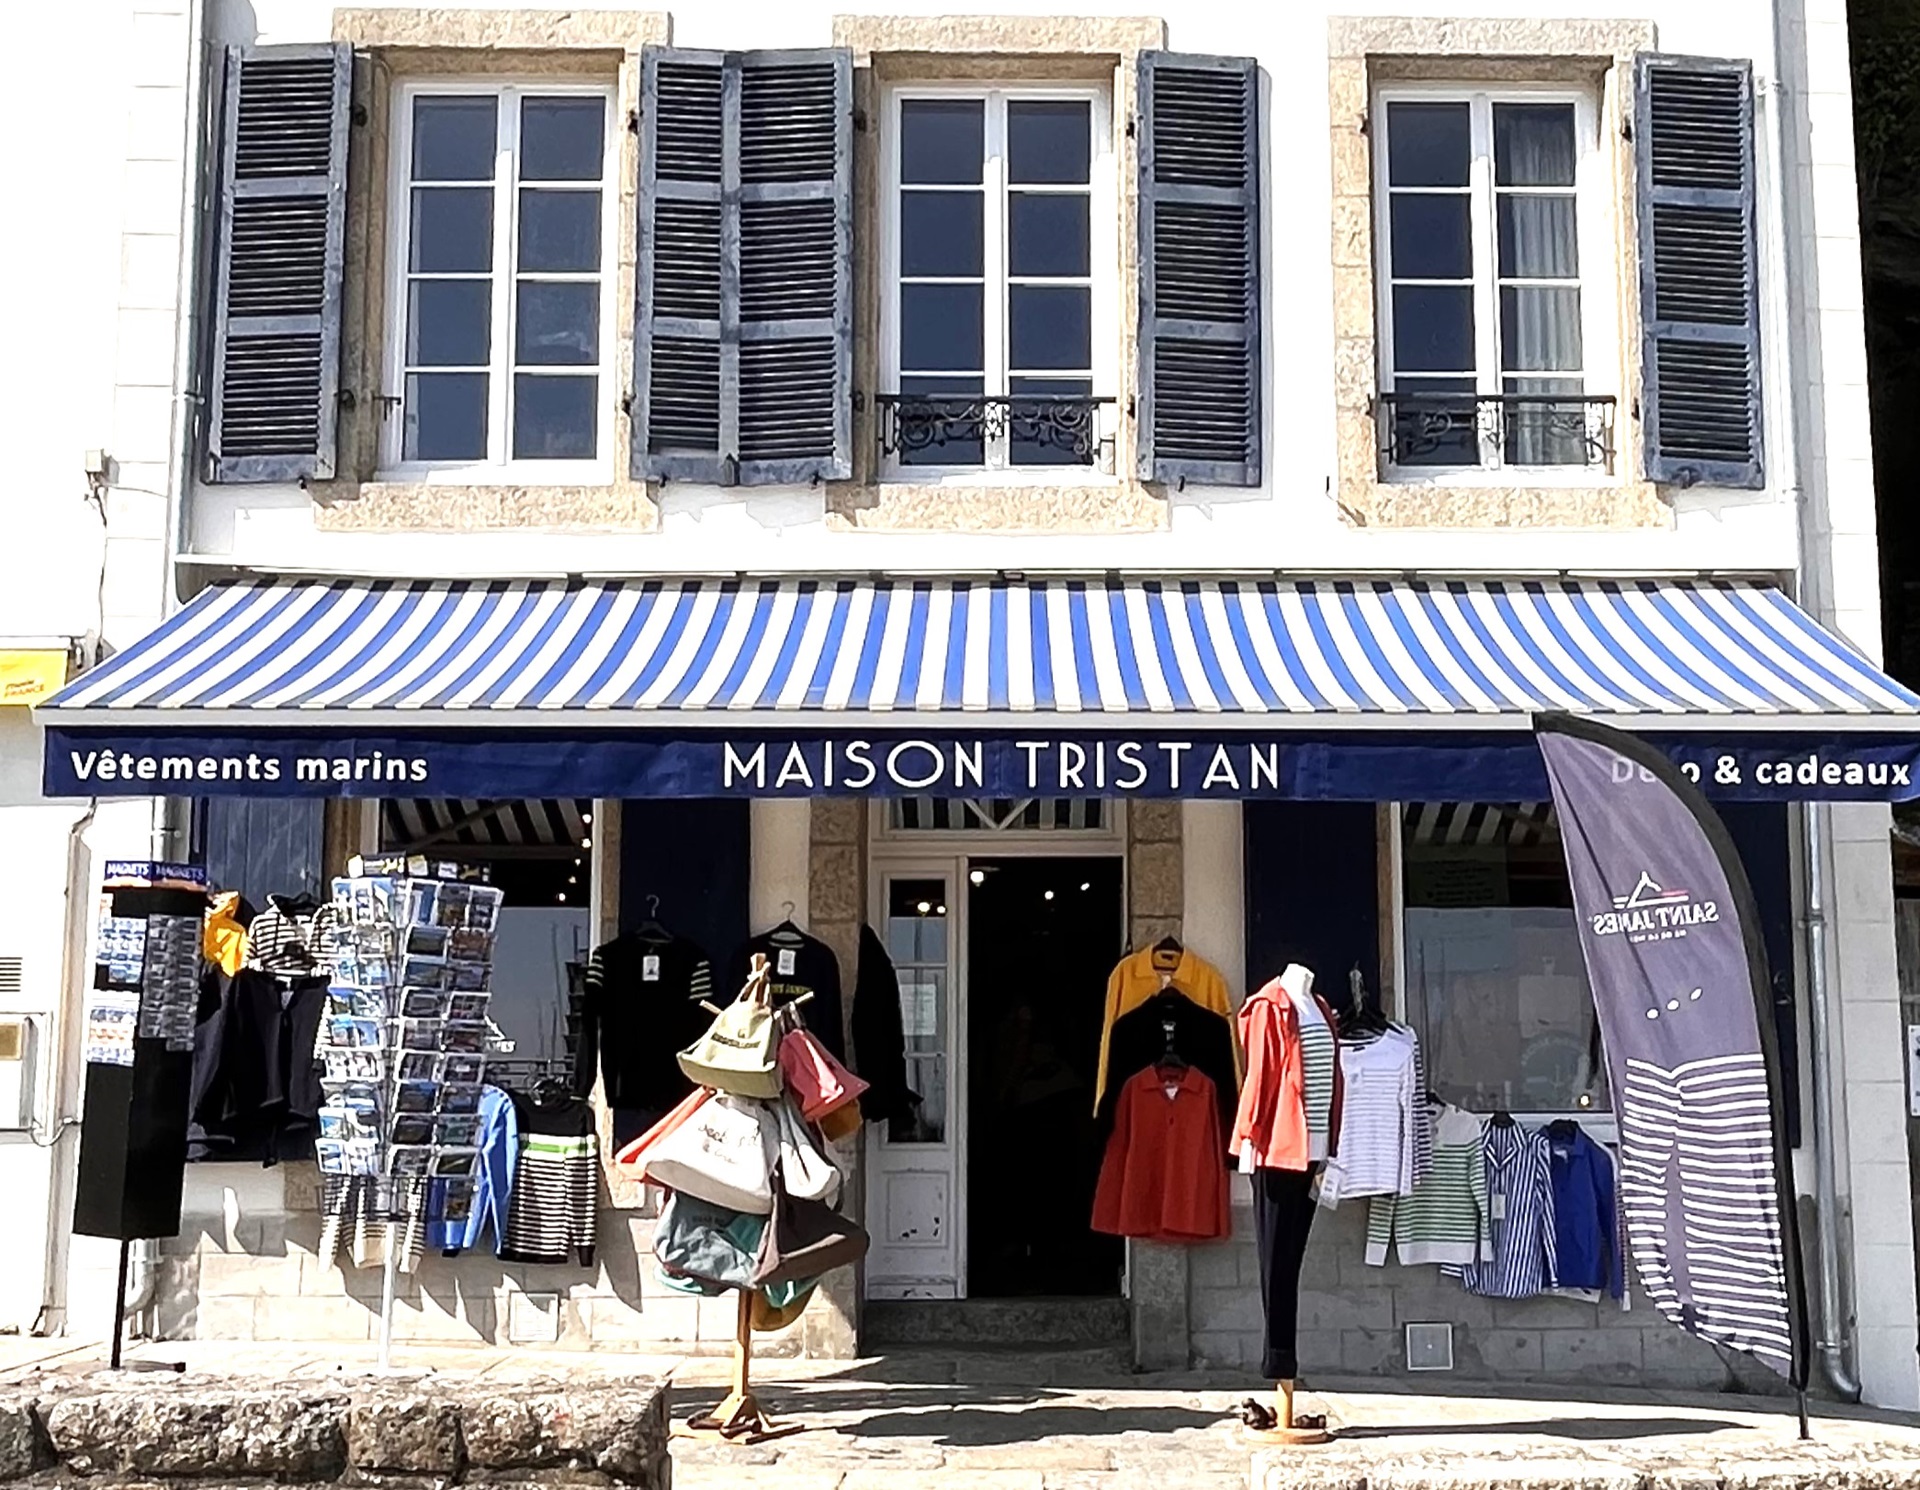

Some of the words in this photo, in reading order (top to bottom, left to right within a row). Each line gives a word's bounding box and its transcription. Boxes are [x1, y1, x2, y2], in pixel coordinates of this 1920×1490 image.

[71, 749, 280, 781] Vêtements
[296, 751, 427, 781] marins
[724, 740, 983, 788] MAISON
[1015, 741, 1278, 790] TRISTAN
[1611, 755, 1700, 784] Do
[1714, 755, 1743, 784] &
[1755, 754, 1911, 785] cadeaux
